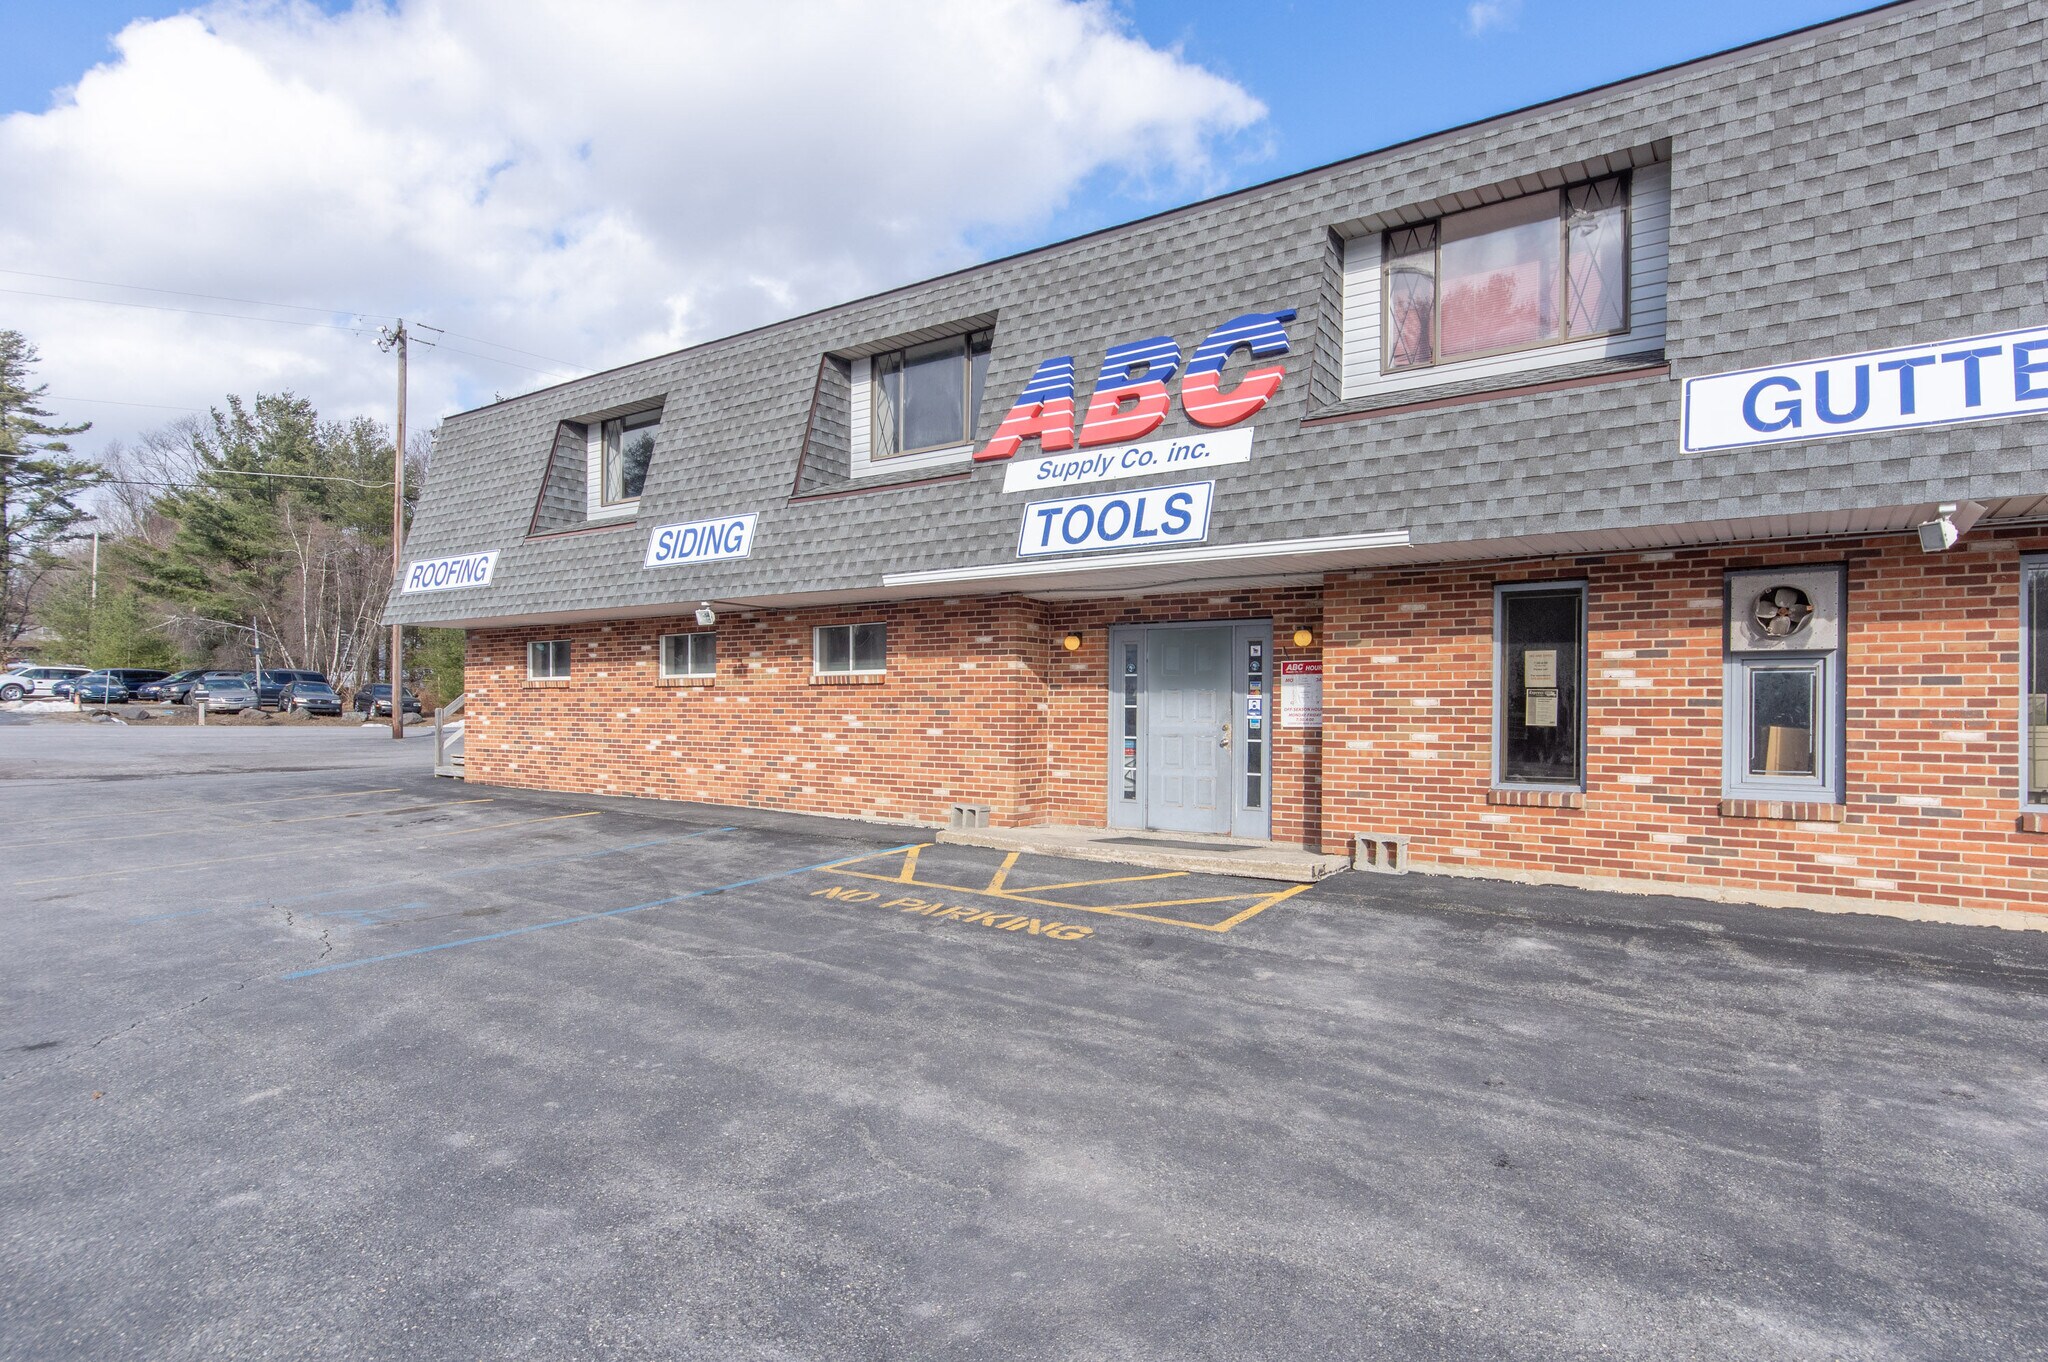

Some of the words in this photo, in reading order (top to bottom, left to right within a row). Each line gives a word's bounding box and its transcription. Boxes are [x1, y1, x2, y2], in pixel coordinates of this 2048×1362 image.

[973, 309, 1297, 462] ABC
[1742, 339, 2048, 433] GUTTE
[1037, 453, 1115, 480] Supply
[1121, 448, 1158, 468] Co.
[1167, 442, 1210, 462] inc.
[656, 521, 745, 561] SIDING
[1037, 492, 1193, 547] TOOLS
[409, 556, 489, 589] ROOFING
[809, 886, 881, 903] NO
[879, 897, 1095, 940] PARKING
